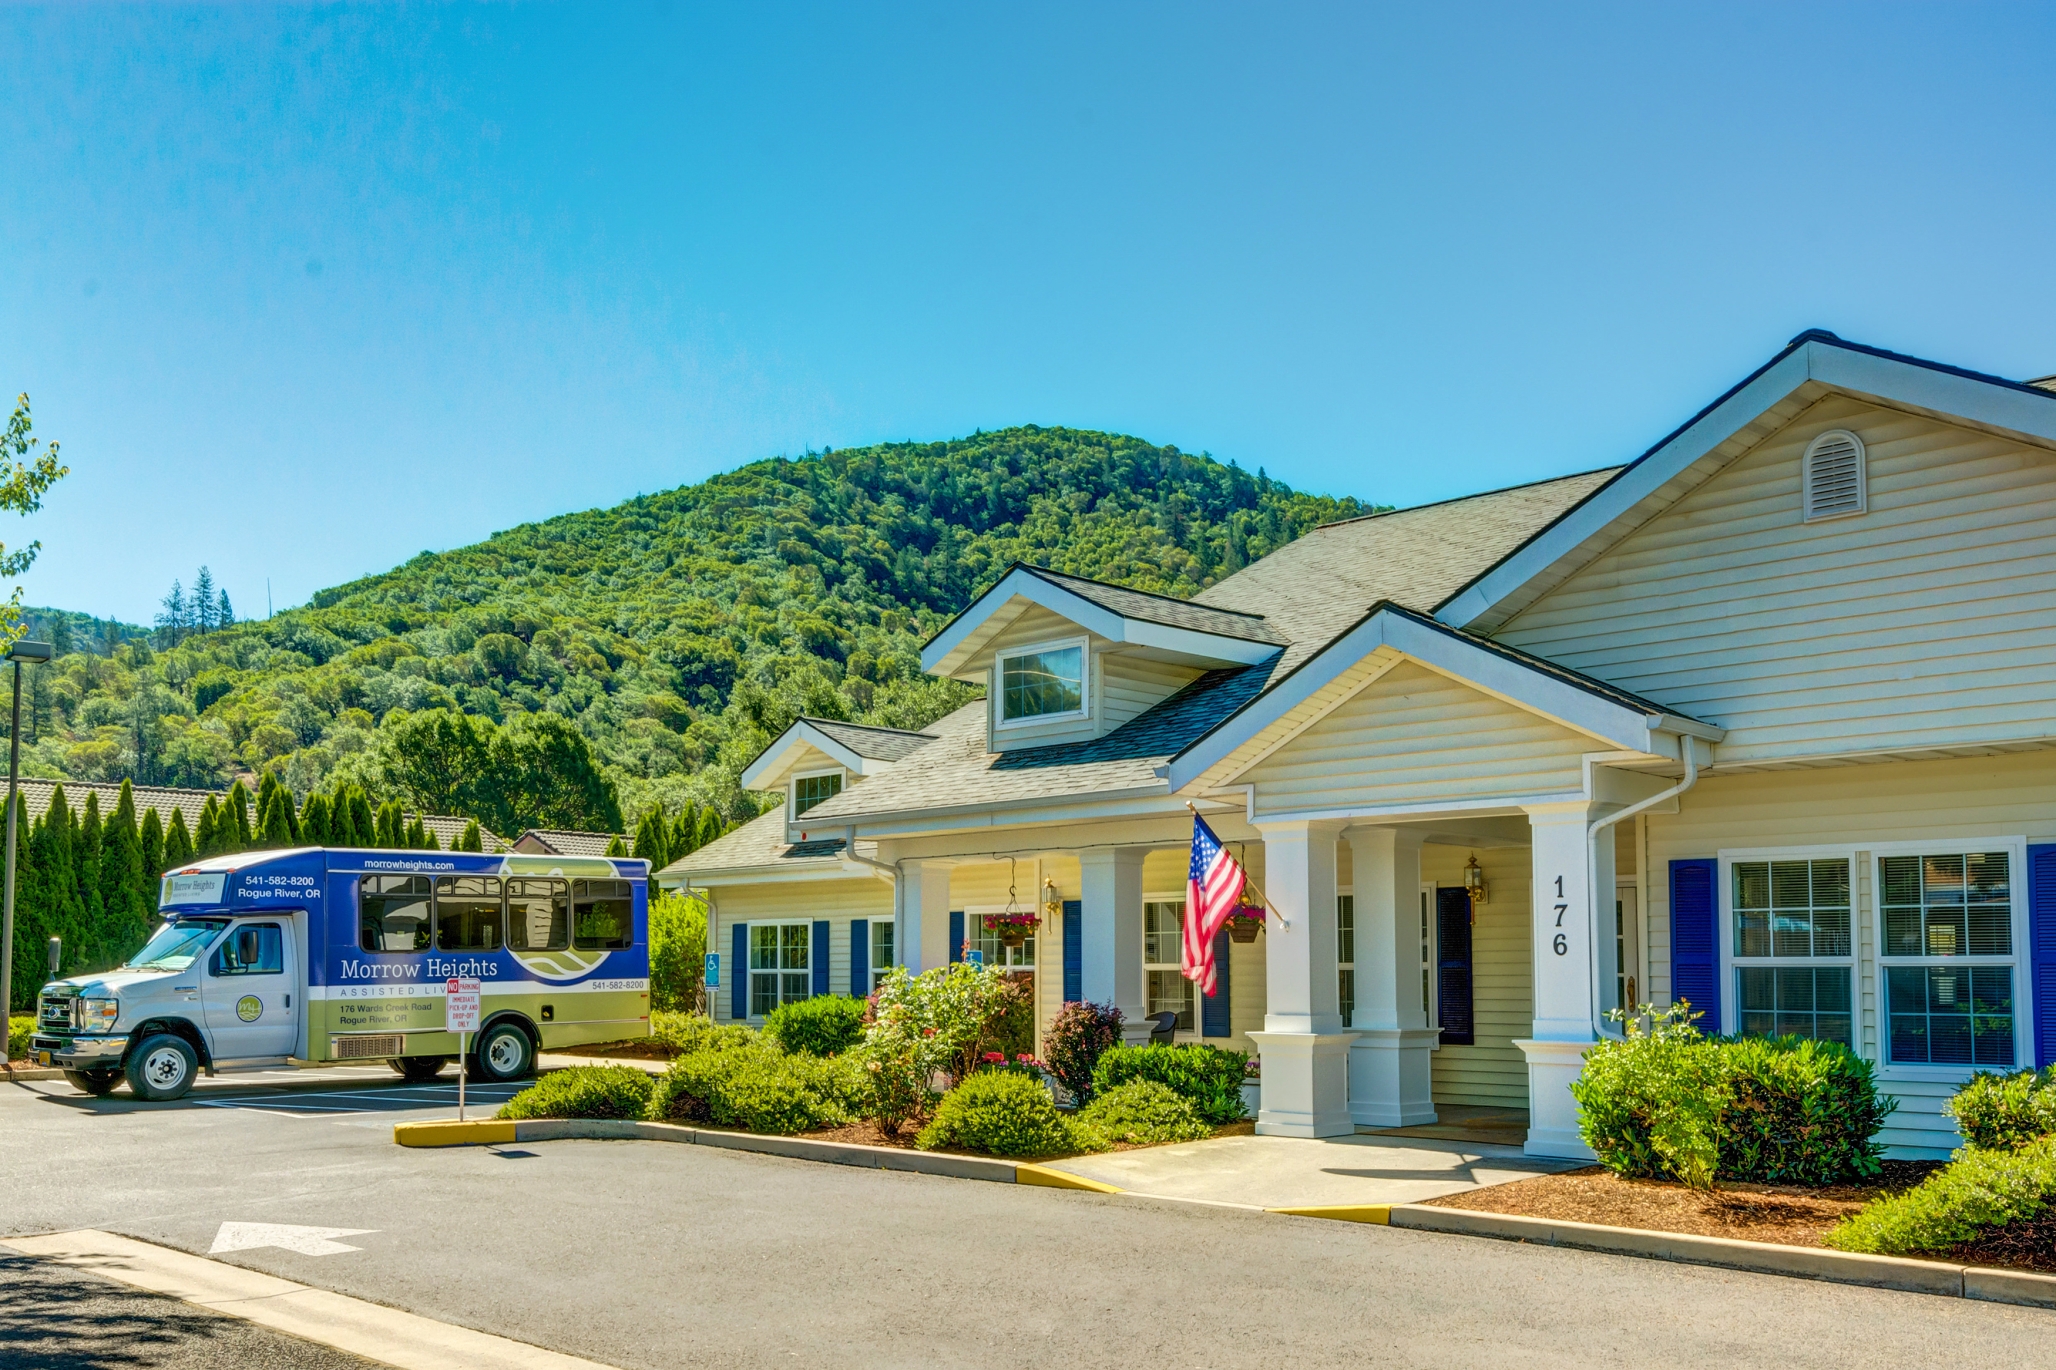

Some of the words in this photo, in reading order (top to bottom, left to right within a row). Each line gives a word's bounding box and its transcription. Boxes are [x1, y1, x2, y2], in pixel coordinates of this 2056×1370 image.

[364, 860, 455, 871] morrowheights.com
[192, 880, 215, 892] Heights
[245, 876, 314, 886] 541-582-8200
[238, 888, 272, 899] Rogue
[274, 889, 303, 899] River,
[305, 890, 321, 898] OR
[340, 959, 421, 979] Morrow
[426, 958, 498, 979] Heights
[448, 982, 458, 992] NO
[592, 981, 644, 990] 541-582-8200
[340, 986, 415, 997] ASSISTED
[340, 1005, 355, 1014] 176
[357, 1004, 383, 1013] Wards
[386, 1003, 409, 1012] Creek
[411, 1002, 432, 1011] Road
[340, 1016, 367, 1026] Rogue
[369, 1015, 393, 1024] River,
[394, 1014, 407, 1023] OR
[452, 1012, 475, 1020] DROP-OFF
[457, 1020, 470, 1028] ONLY
